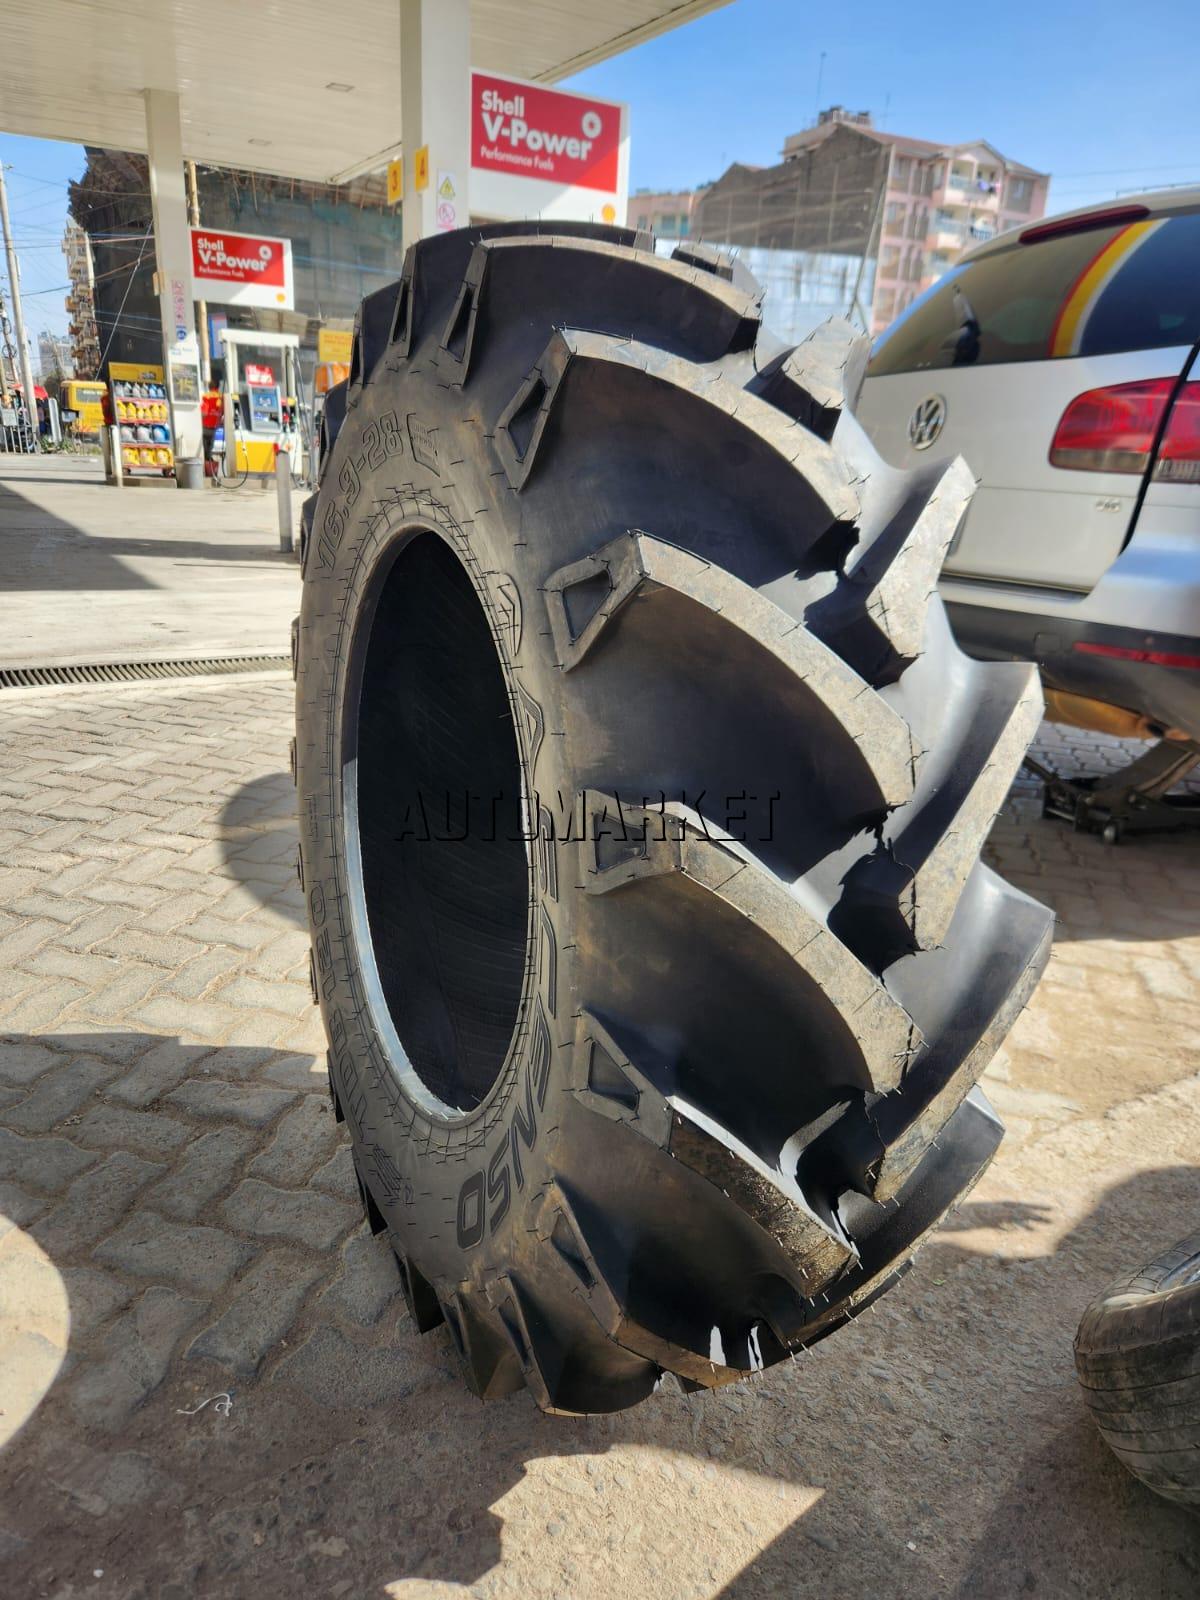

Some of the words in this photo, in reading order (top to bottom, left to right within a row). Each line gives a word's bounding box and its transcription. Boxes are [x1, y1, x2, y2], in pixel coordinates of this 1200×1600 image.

[481, 90, 525, 118] Shell
[481, 112, 593, 161] V-Power
[480, 145, 532, 167] Performance
[197, 238, 224, 251] Shell
[198, 249, 268, 272] V-Power
[318, 410, 403, 571] 16.9-28
